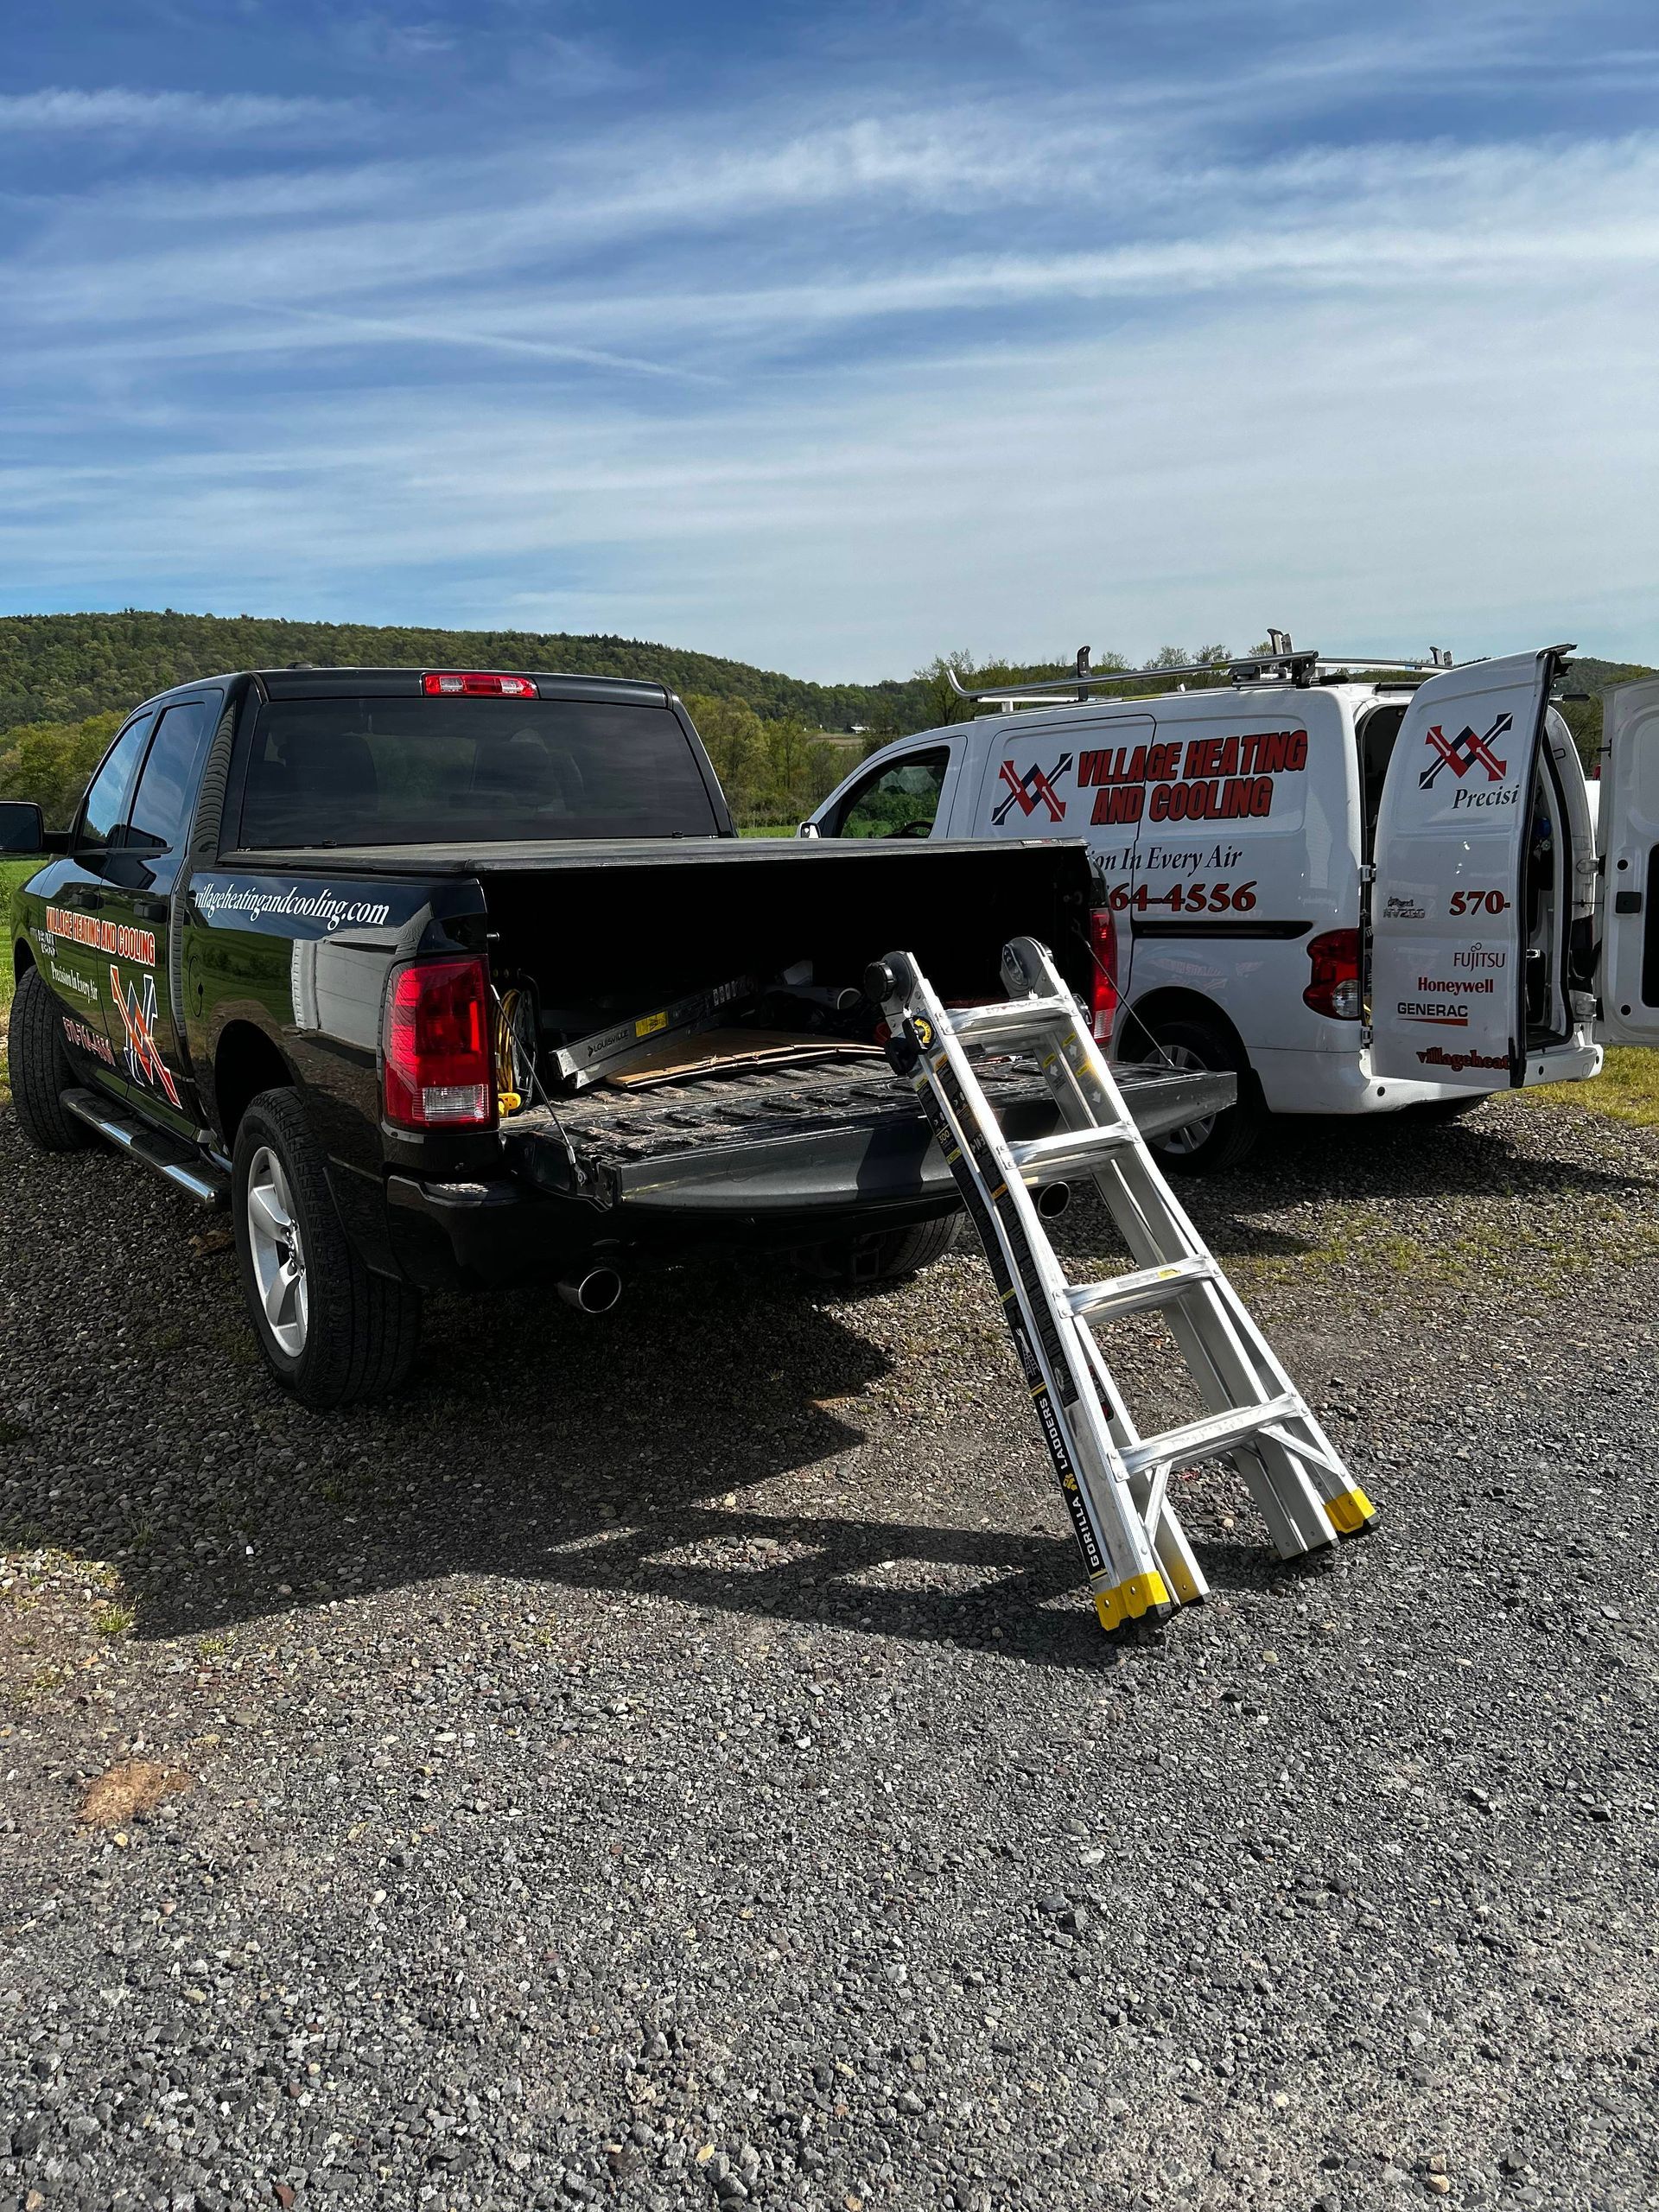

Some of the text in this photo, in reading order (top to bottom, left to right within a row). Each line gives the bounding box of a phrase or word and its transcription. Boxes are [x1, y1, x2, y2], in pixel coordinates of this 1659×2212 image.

[1077, 729, 1308, 788] VILLAGE HEATING
[1090, 776, 1274, 826] AND COOLING
[1117, 848, 1141, 871] In
[1145, 847, 1203, 878] Every
[1206, 844, 1243, 869] Air
[193, 882, 391, 931] villageheatingandcooling.com
[1107, 880, 1258, 912] 64-4556
[1449, 890, 1511, 916] 570-
[46, 906, 156, 967] VILLAGE HEATING AND COOLING
[50, 961, 71, 987] Precision
[1453, 950, 1506, 972] FUJITSU
[1418, 977, 1494, 996] Honeywell
[1397, 1002, 1468, 1017] GENERAC
[593, 1031, 627, 1052] LOUISVILLE
[938, 1129, 950, 1144] 300
[1039, 1397, 1099, 1568] GORILLA LADDERS
